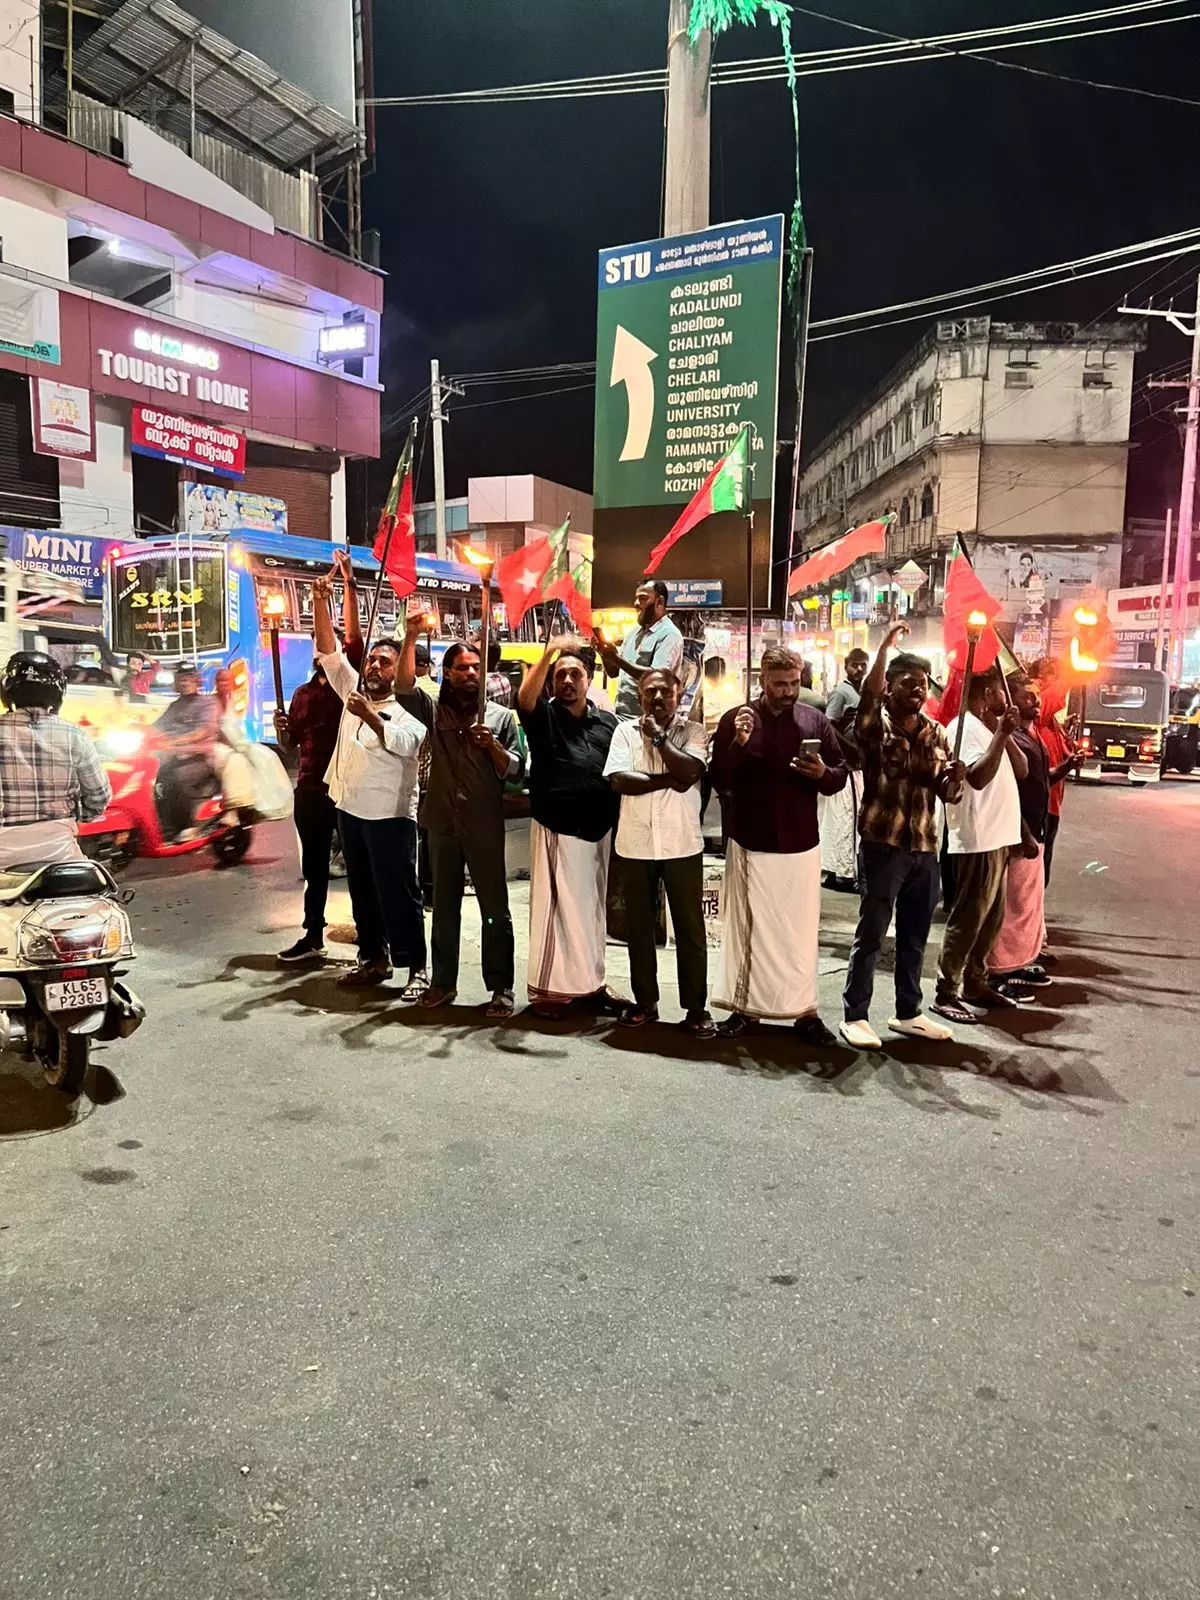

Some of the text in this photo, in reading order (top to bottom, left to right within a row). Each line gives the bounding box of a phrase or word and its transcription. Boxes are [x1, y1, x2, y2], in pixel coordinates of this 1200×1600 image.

[605, 251, 651, 284] STU
[670, 274, 732, 299] കടലുണ്ടി
[670, 293, 742, 317] KADALUNDI
[669, 315, 725, 334] ചാലിയം
[669, 331, 733, 352] CHALIYAM
[668, 349, 718, 370] ചേളാരി
[98, 348, 191, 396] TOURIST
[196, 376, 249, 412] HOME
[668, 368, 720, 387] CHELARI
[667, 402, 741, 422] UNIVERSITY
[145, 427, 193, 451] ബുക്ക്
[26, 533, 92, 563] MINI
[15, 559, 100, 577] SUPER MARKET &
[441, 580, 471, 593] PRINCE
[1124, 631, 1145, 641] SERVICE
[63, 980, 97, 994] KL65
[60, 992, 102, 1008] P2363
